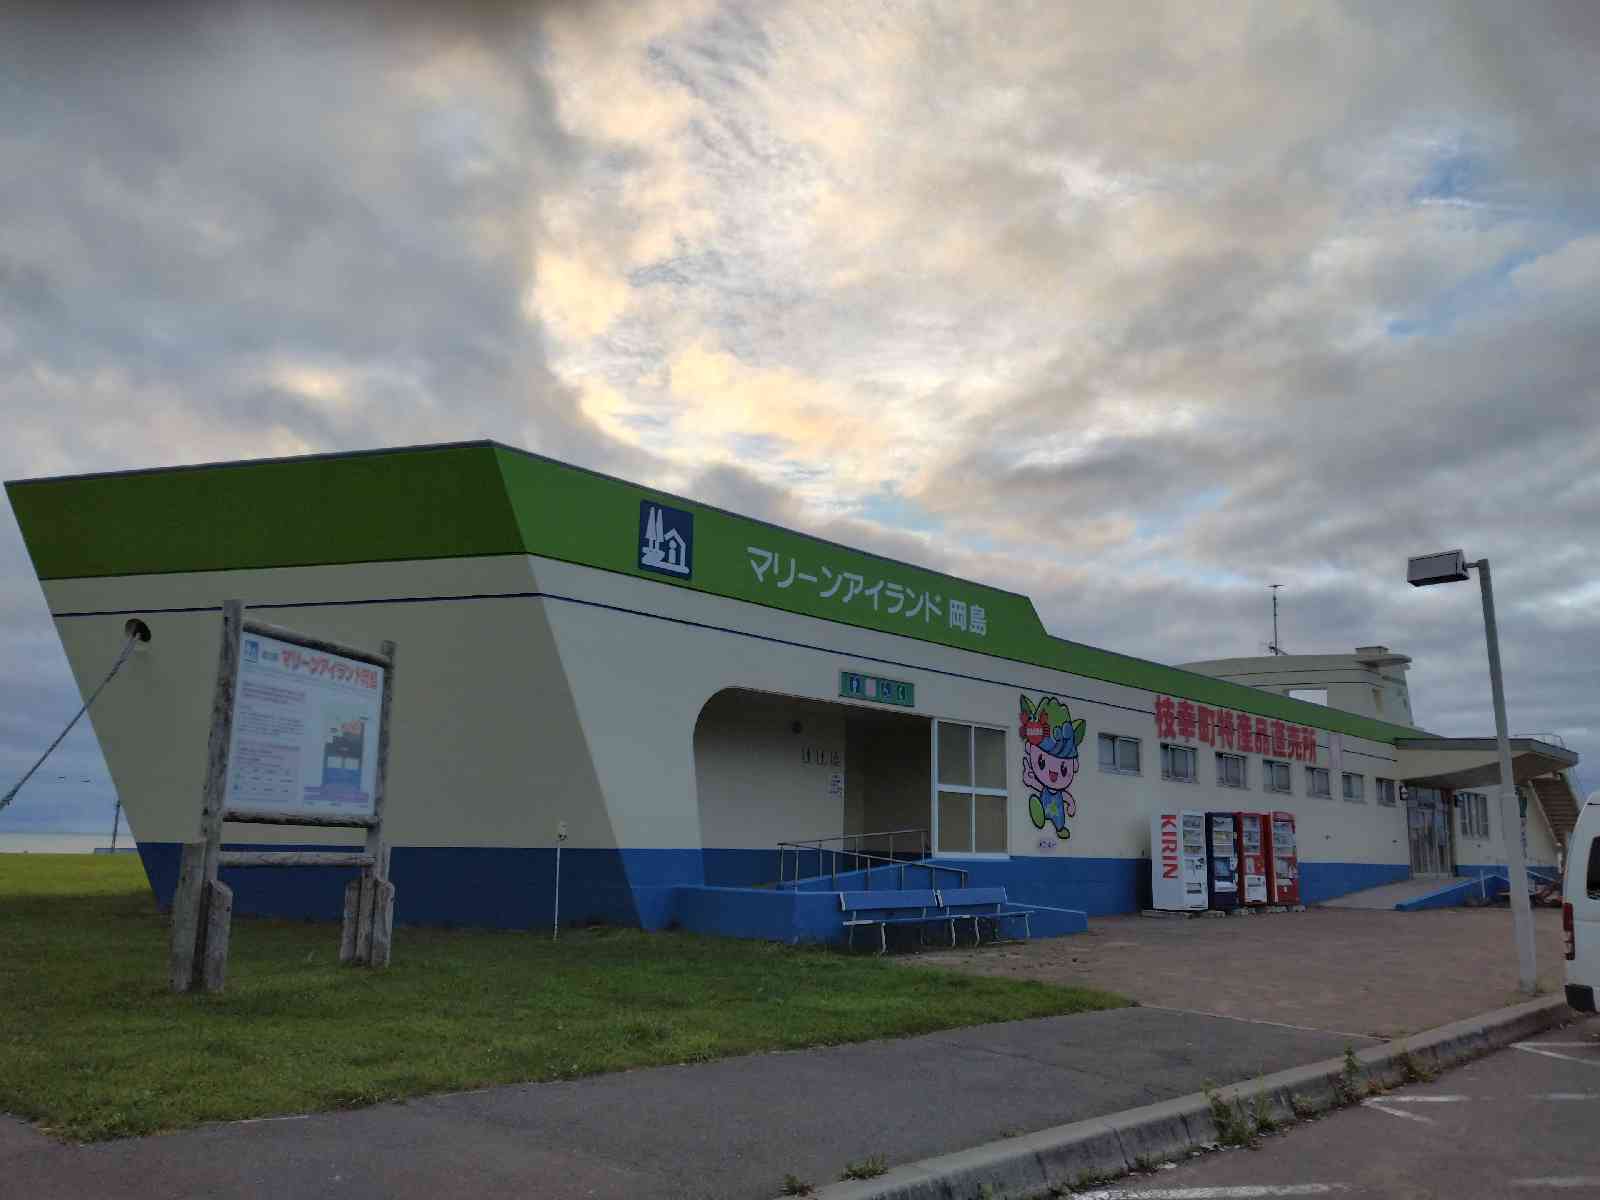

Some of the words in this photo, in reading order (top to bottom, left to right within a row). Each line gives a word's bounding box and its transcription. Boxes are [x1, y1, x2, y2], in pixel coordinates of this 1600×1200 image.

[746, 546, 942, 623] マリーンアイランド
[949, 599, 987, 636] 岡島
[1161, 814, 1179, 880] KIRIN
